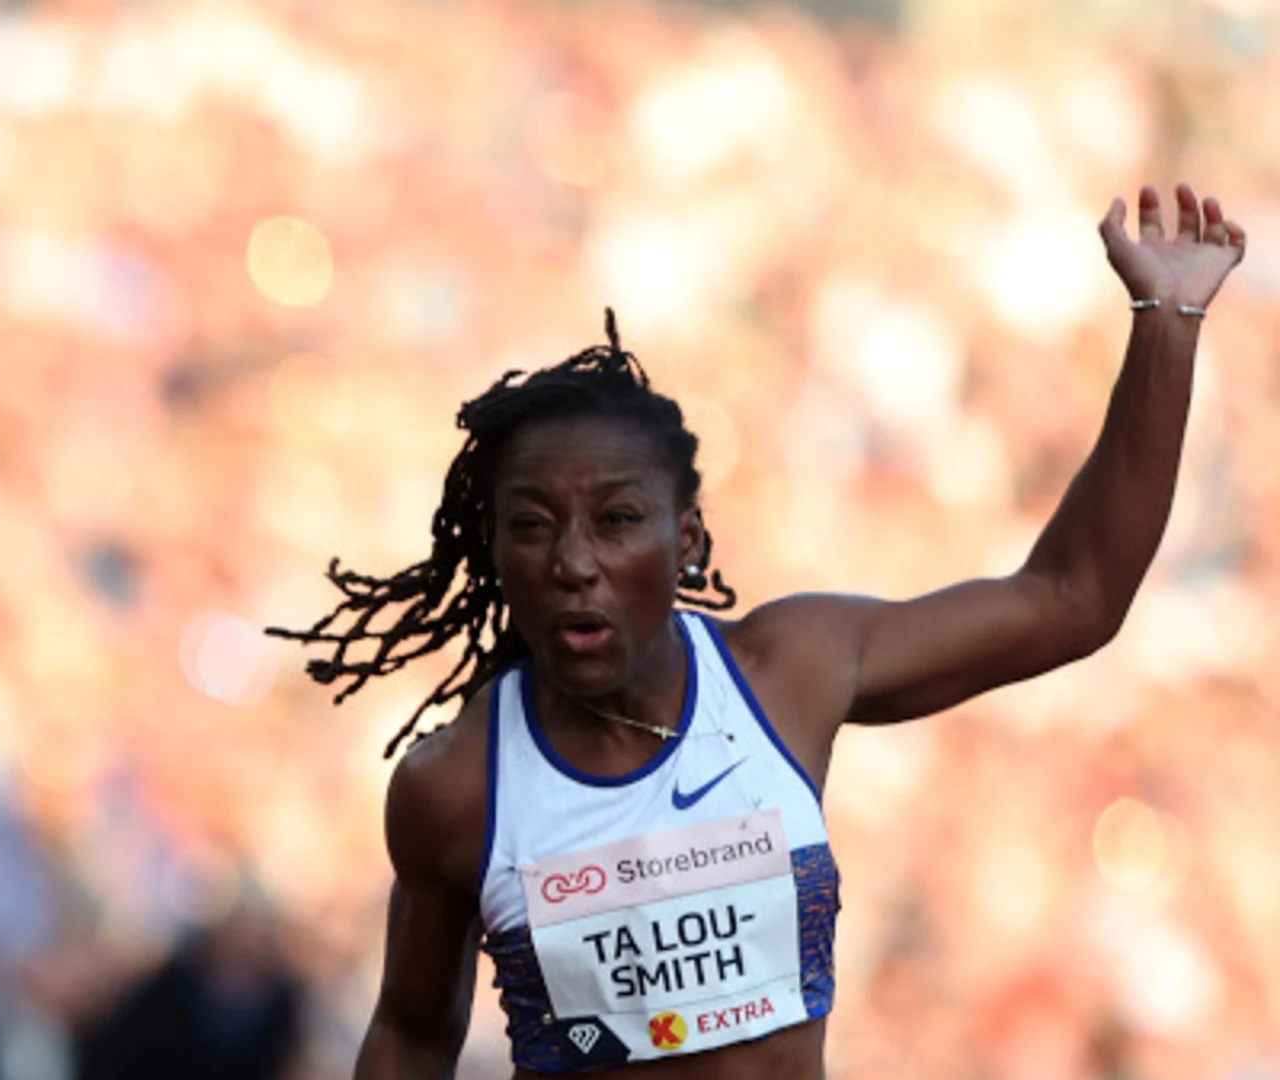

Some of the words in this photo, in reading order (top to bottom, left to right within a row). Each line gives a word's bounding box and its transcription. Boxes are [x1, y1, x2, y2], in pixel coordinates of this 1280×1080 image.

[616, 832, 774, 884] Storebrand
[583, 926, 641, 964] TA
[652, 904, 756, 953] LOU-
[611, 946, 745, 998] SMITH
[697, 997, 776, 1034] EXTRA
